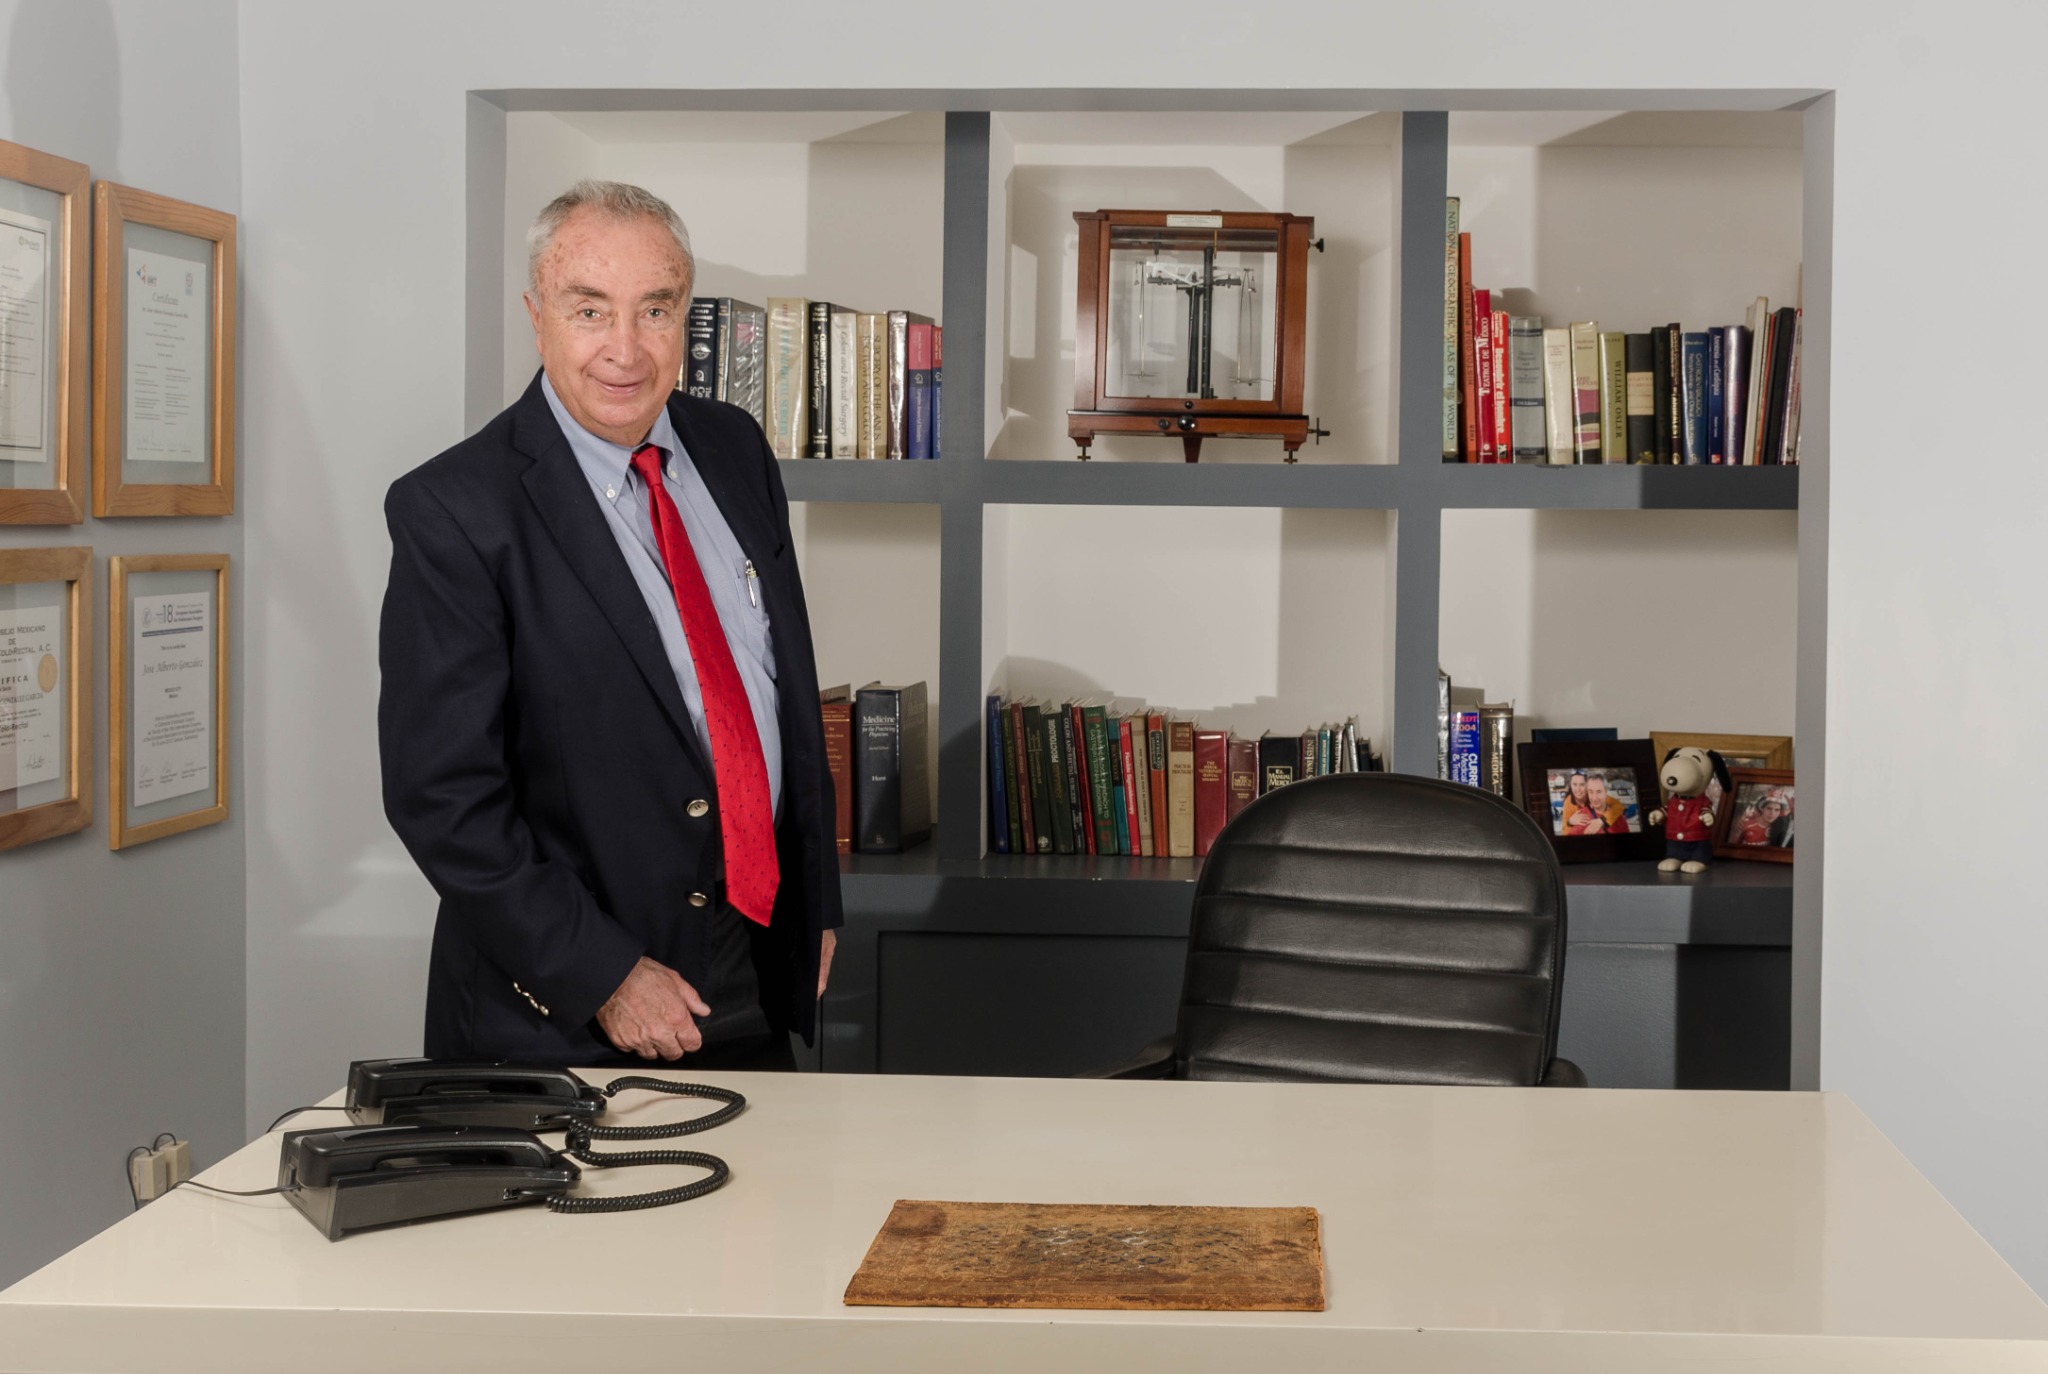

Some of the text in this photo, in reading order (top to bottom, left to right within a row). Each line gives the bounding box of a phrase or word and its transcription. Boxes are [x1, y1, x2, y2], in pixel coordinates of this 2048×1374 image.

[1447, 210, 1456, 263] NATIONAL
[152, 292, 180, 306] Certificate
[1447, 264, 1456, 329] GEOGRAPHIC
[819, 333, 827, 360] CURRENT
[1446, 333, 1455, 363] ATLAS
[1466, 329, 1474, 386] HISTOLOGIA
[838, 331, 848, 437] Colon and Rectal Surgery
[1447, 365, 1455, 378] OF
[1478, 360, 1491, 397] TEATROS
[1695, 352, 1703, 418] GASTROENTEROLOGY
[811, 387, 820, 410] Surgery
[862, 378, 871, 404] AND
[873, 335, 881, 441] SURGERY OF THE ANUS
[1495, 347, 1506, 434] Descubrir el hombre
[862, 406, 871, 441] COLON
[1446, 404, 1455, 440] WORLD
[1615, 406, 1623, 438] OSLER
[162, 604, 174, 624] 18
[8, 638, 16, 646] DE
[17, 625, 46, 634] MEXICANO
[862, 715, 896, 724] Medicine
[875, 726, 896, 734] Practicing
[1063, 717, 1071, 739] COLON
[1455, 723, 1477, 732] 2004
[1047, 718, 1059, 764] PROCTOLOGIE
[1452, 753, 1460, 762] &
[1460, 752, 1469, 783] Medical
[1491, 751, 1499, 785] MEDICA
[1126, 774, 1135, 816] Sigmoidoscopy
[1268, 778, 1291, 787] MERCK
